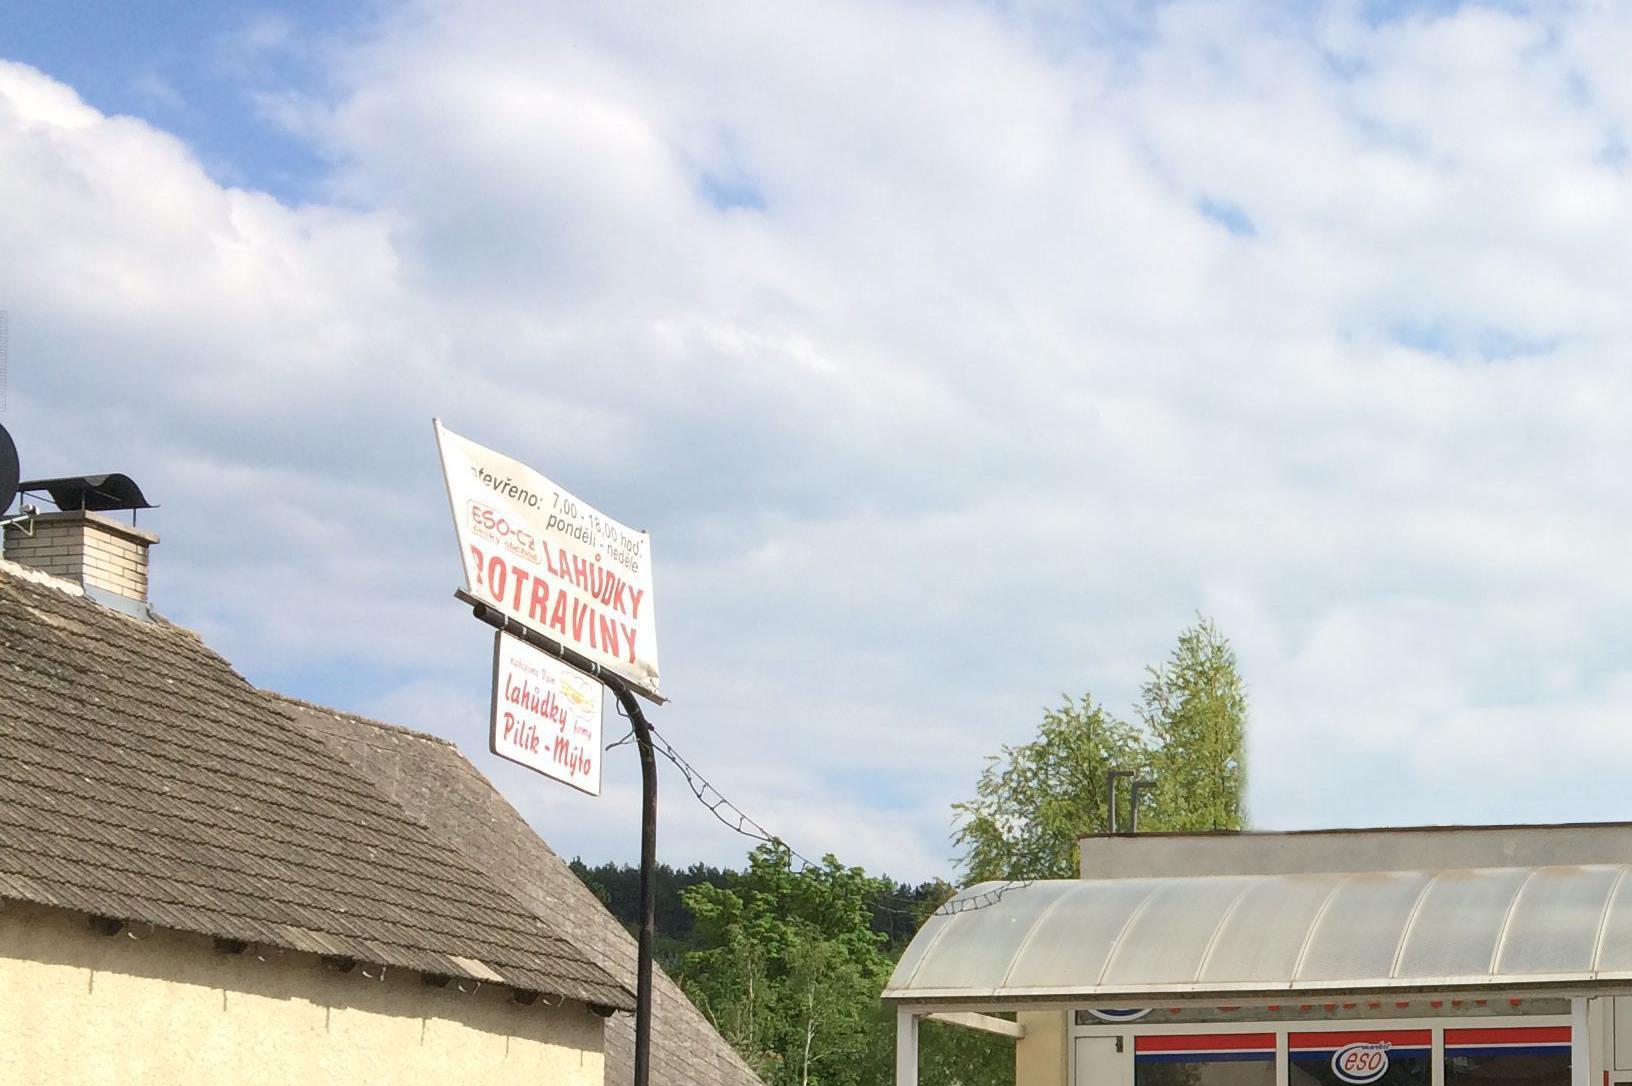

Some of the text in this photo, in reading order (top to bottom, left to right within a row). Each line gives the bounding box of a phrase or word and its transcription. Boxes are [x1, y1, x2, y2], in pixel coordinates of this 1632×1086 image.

[552, 492, 577, 519] 7,00
[542, 541, 644, 620] LAHŮDKY
[505, 671, 568, 733] lahůdky
[553, 735, 592, 777] Mýto
[1345, 1052, 1382, 1071] eso
